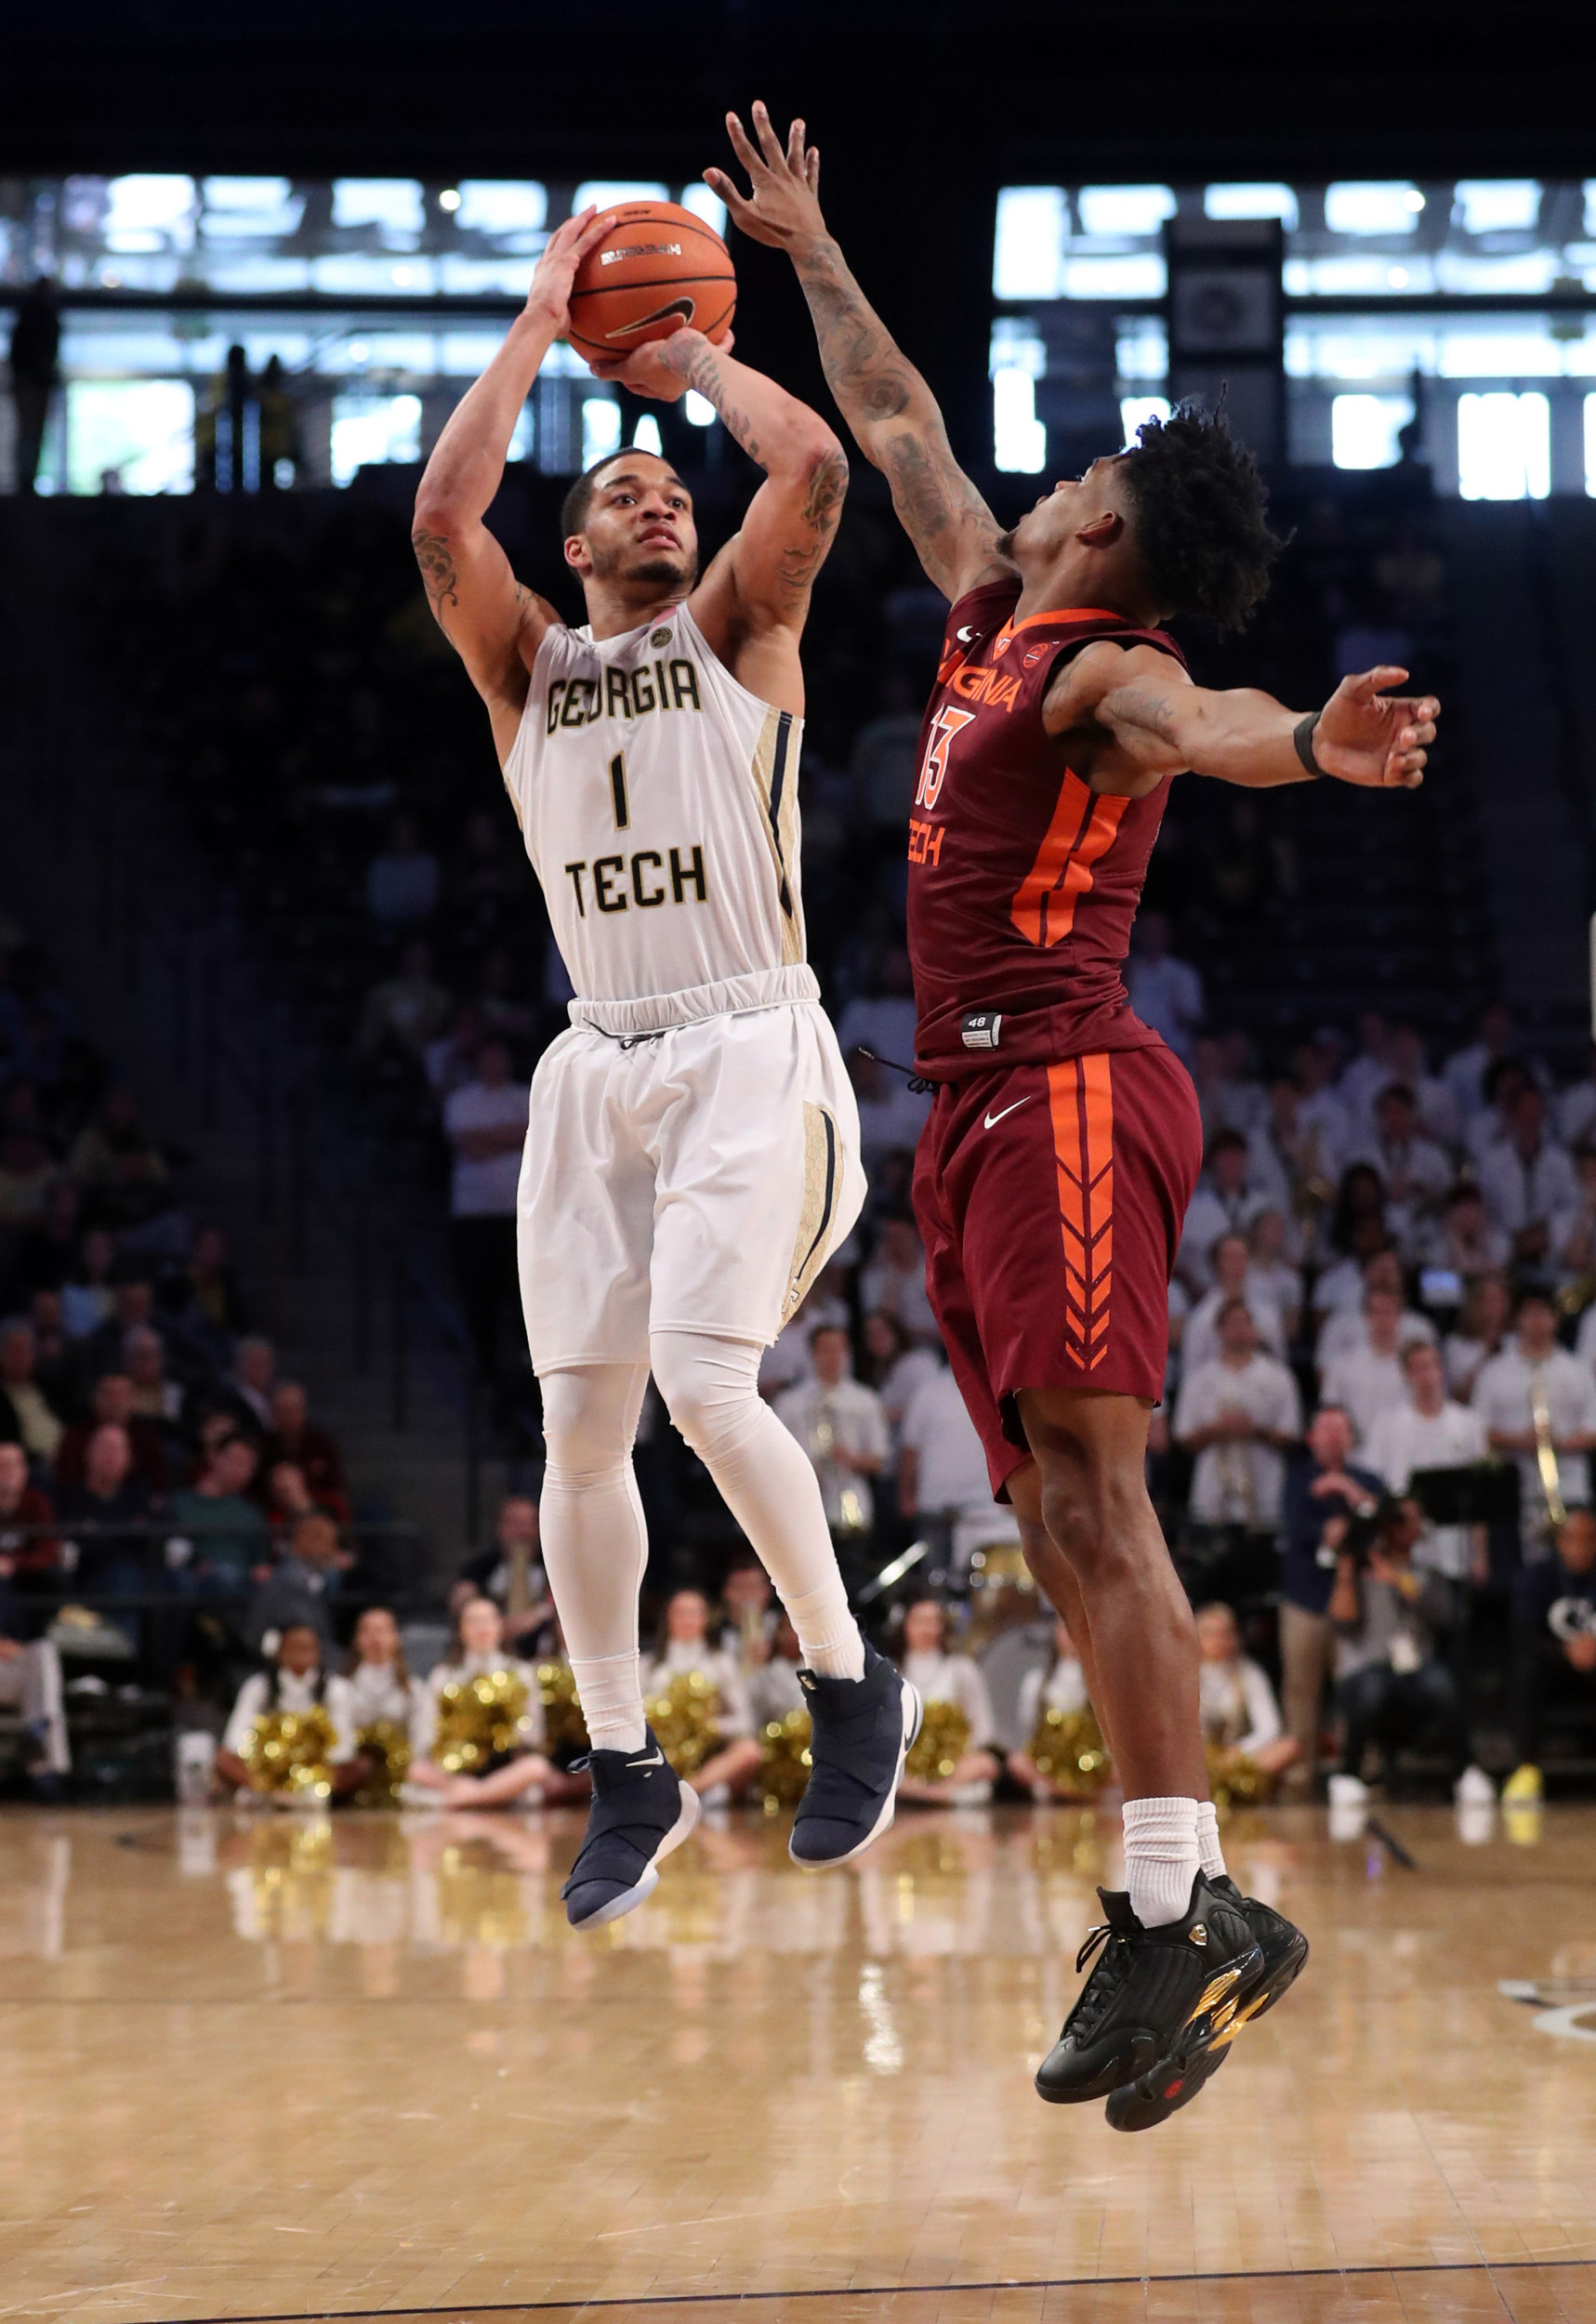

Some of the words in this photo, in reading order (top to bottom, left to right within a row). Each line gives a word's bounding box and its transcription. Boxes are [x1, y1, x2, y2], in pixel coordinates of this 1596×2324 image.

[547, 659, 702, 737] GEORGIA
[609, 750, 629, 831] 1
[915, 703, 976, 811] 13
[907, 818, 946, 867] ECH
[564, 845, 707, 918] TECH
[968, 1016, 986, 1028] 48
